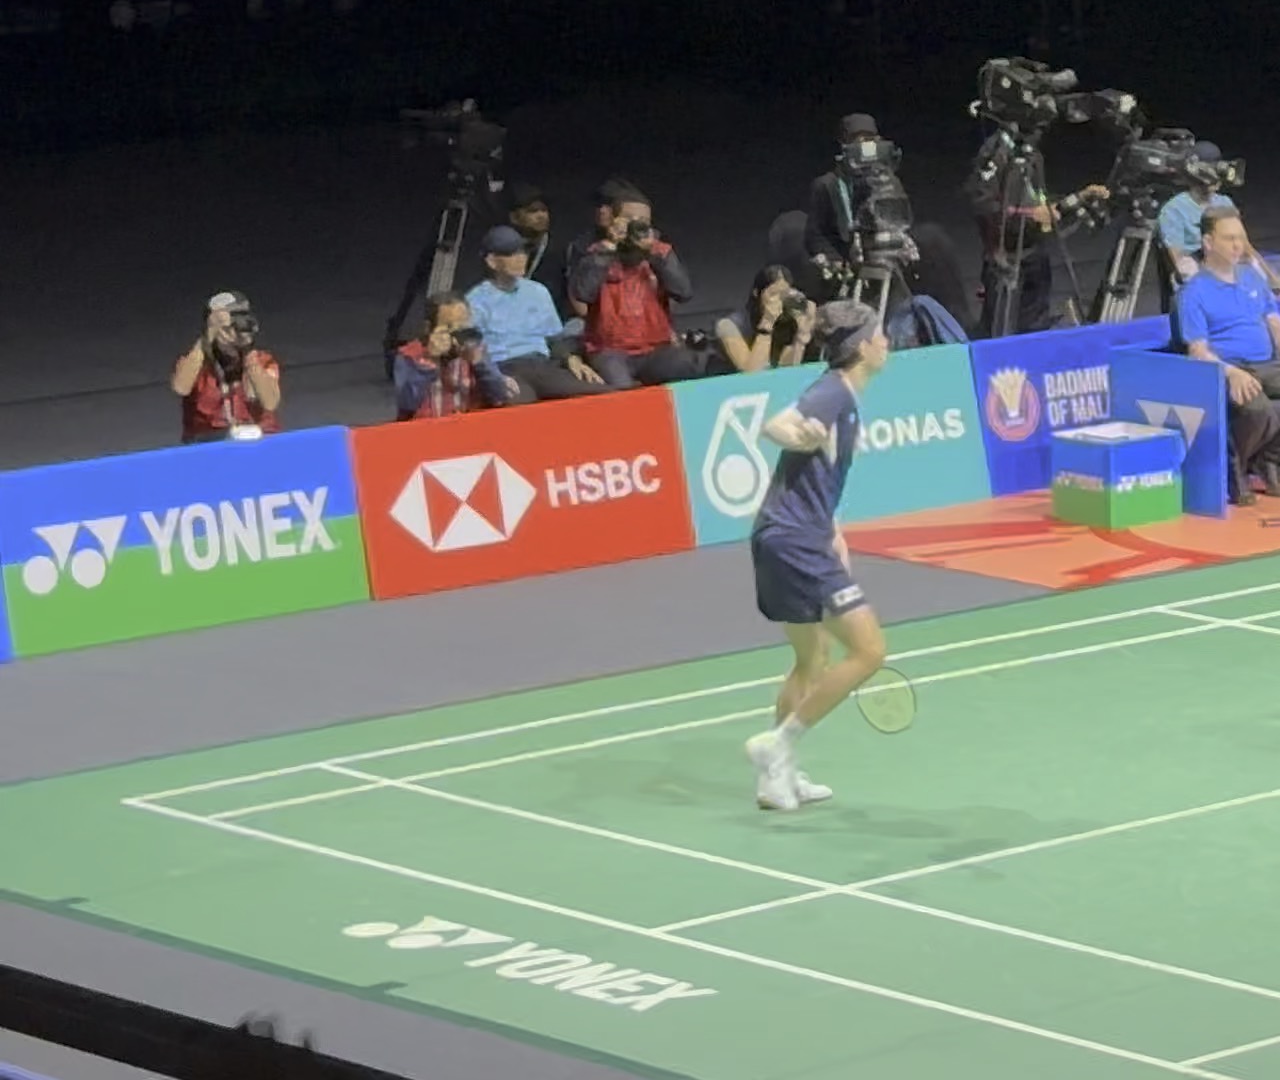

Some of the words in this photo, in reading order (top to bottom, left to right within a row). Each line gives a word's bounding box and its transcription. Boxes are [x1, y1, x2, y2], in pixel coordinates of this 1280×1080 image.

[1048, 398, 1067, 427] OF
[545, 453, 662, 509] HSBC
[139, 486, 338, 576] YONEX
[463, 941, 720, 1012] YONEX
